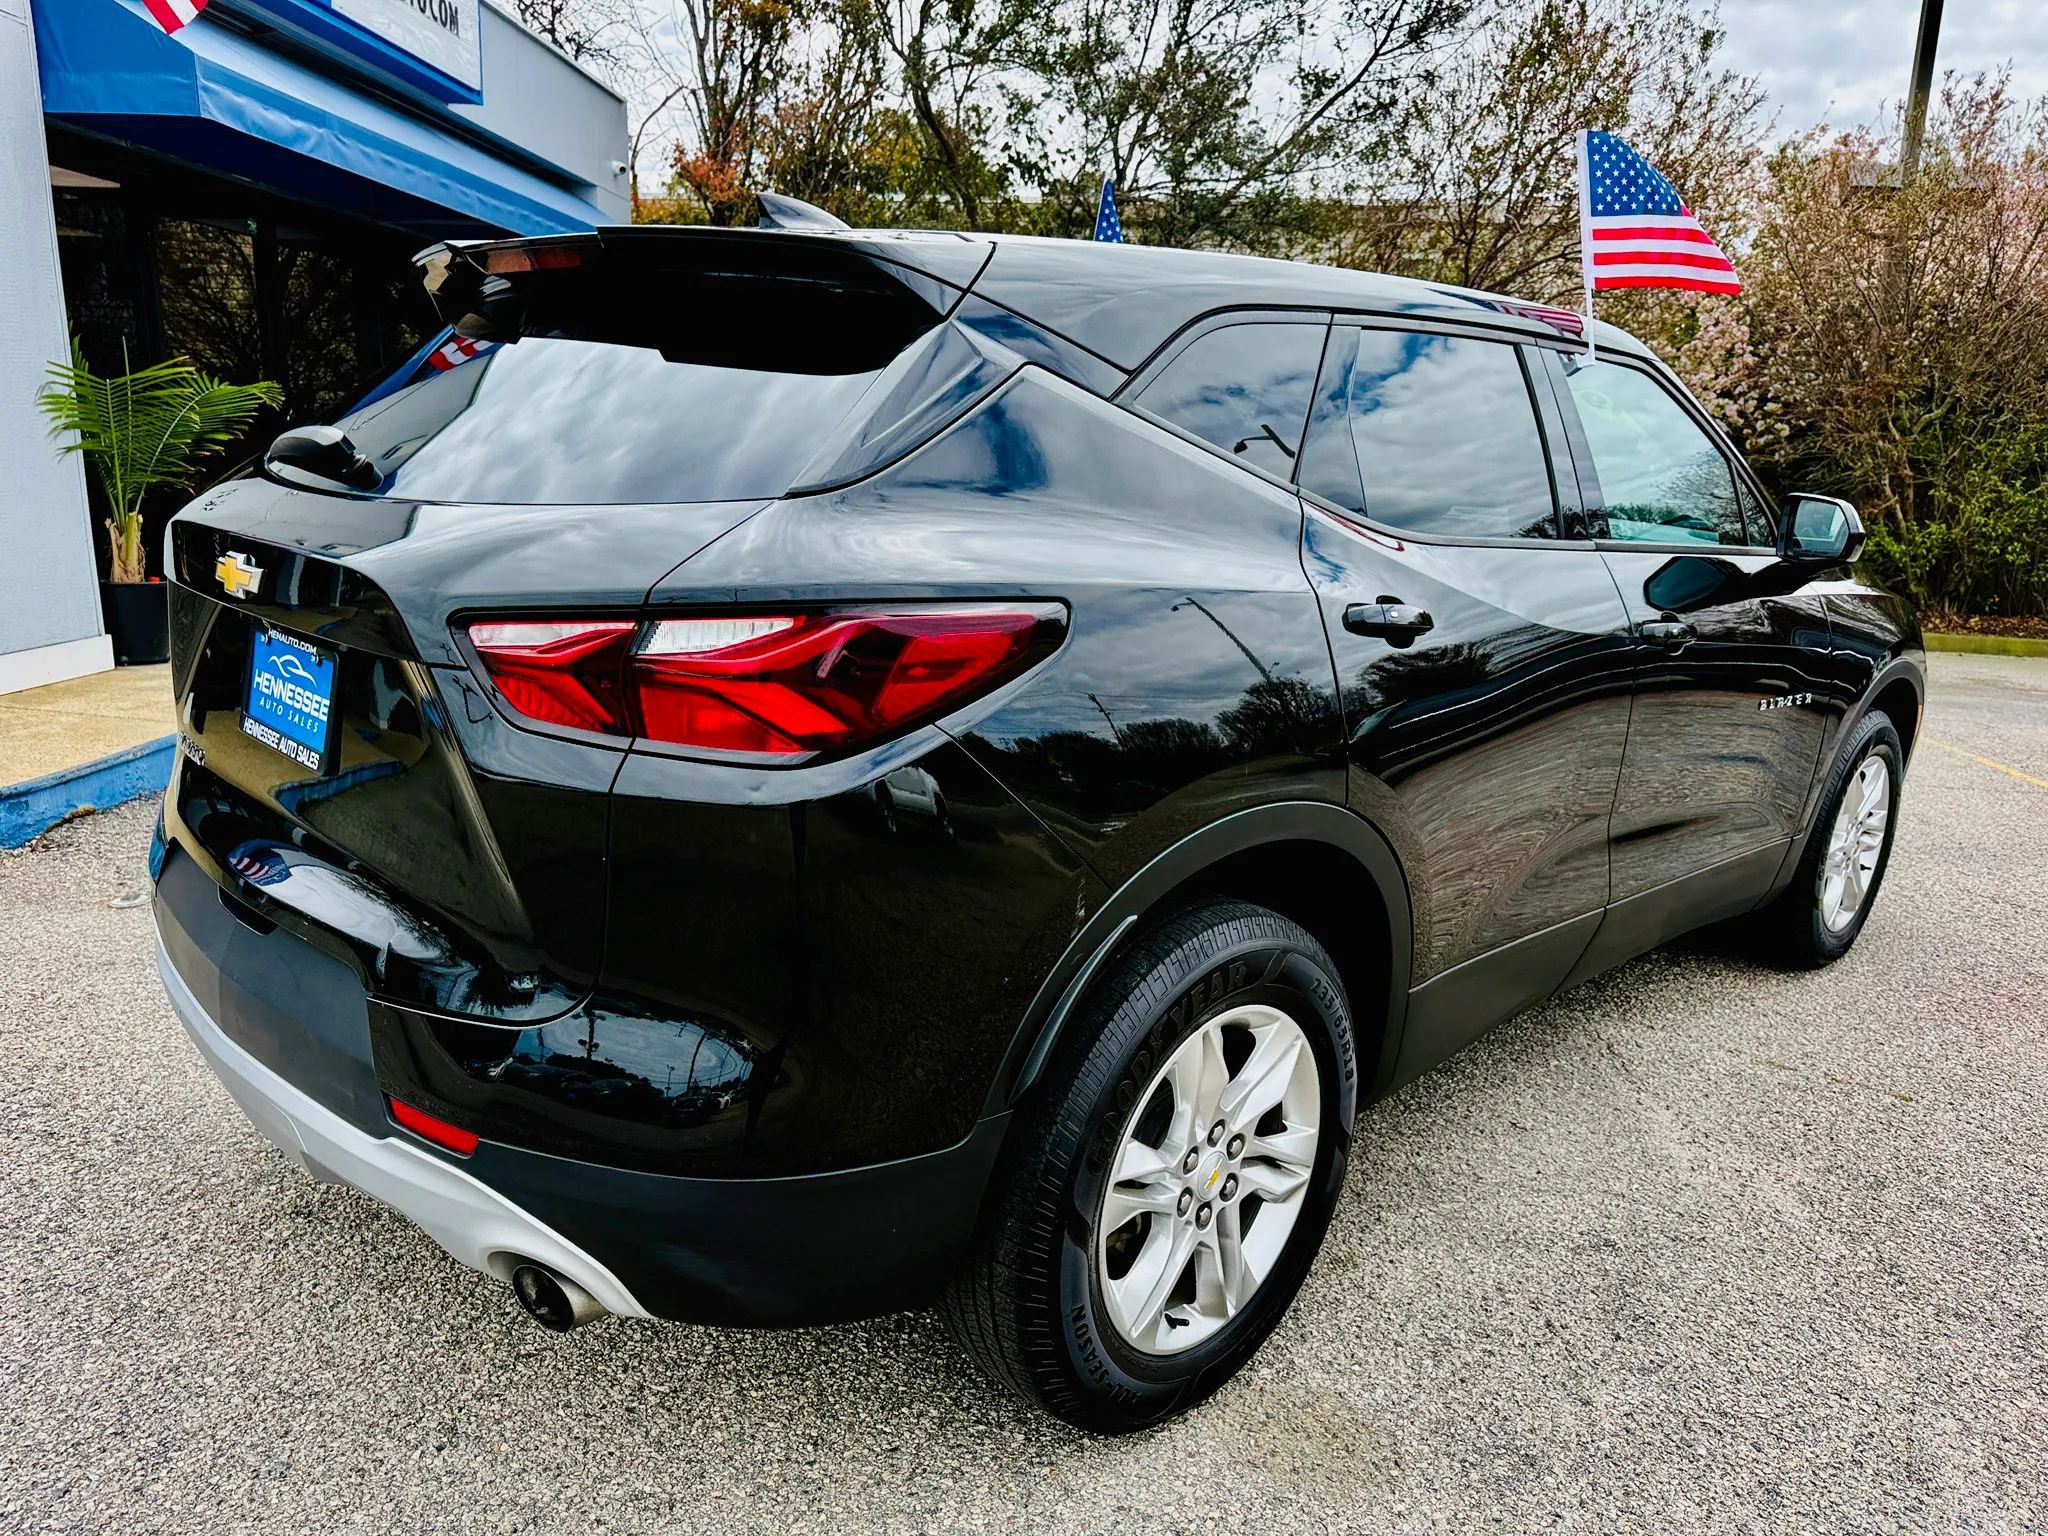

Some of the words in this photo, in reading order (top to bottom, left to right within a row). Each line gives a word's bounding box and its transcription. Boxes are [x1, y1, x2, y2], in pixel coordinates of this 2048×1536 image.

[268, 629, 317, 655] HENAUTO.COM
[254, 669, 330, 721] HENNESSEE
[259, 697, 284, 716] AUTO
[288, 711, 319, 733] SALES
[1760, 693, 1812, 711] BLAZER
[243, 717, 279, 749] HENNESSEE
[278, 736, 297, 758] AUTO
[296, 743, 320, 770] SALES
[1087, 960, 1247, 1178] OODYEAR
